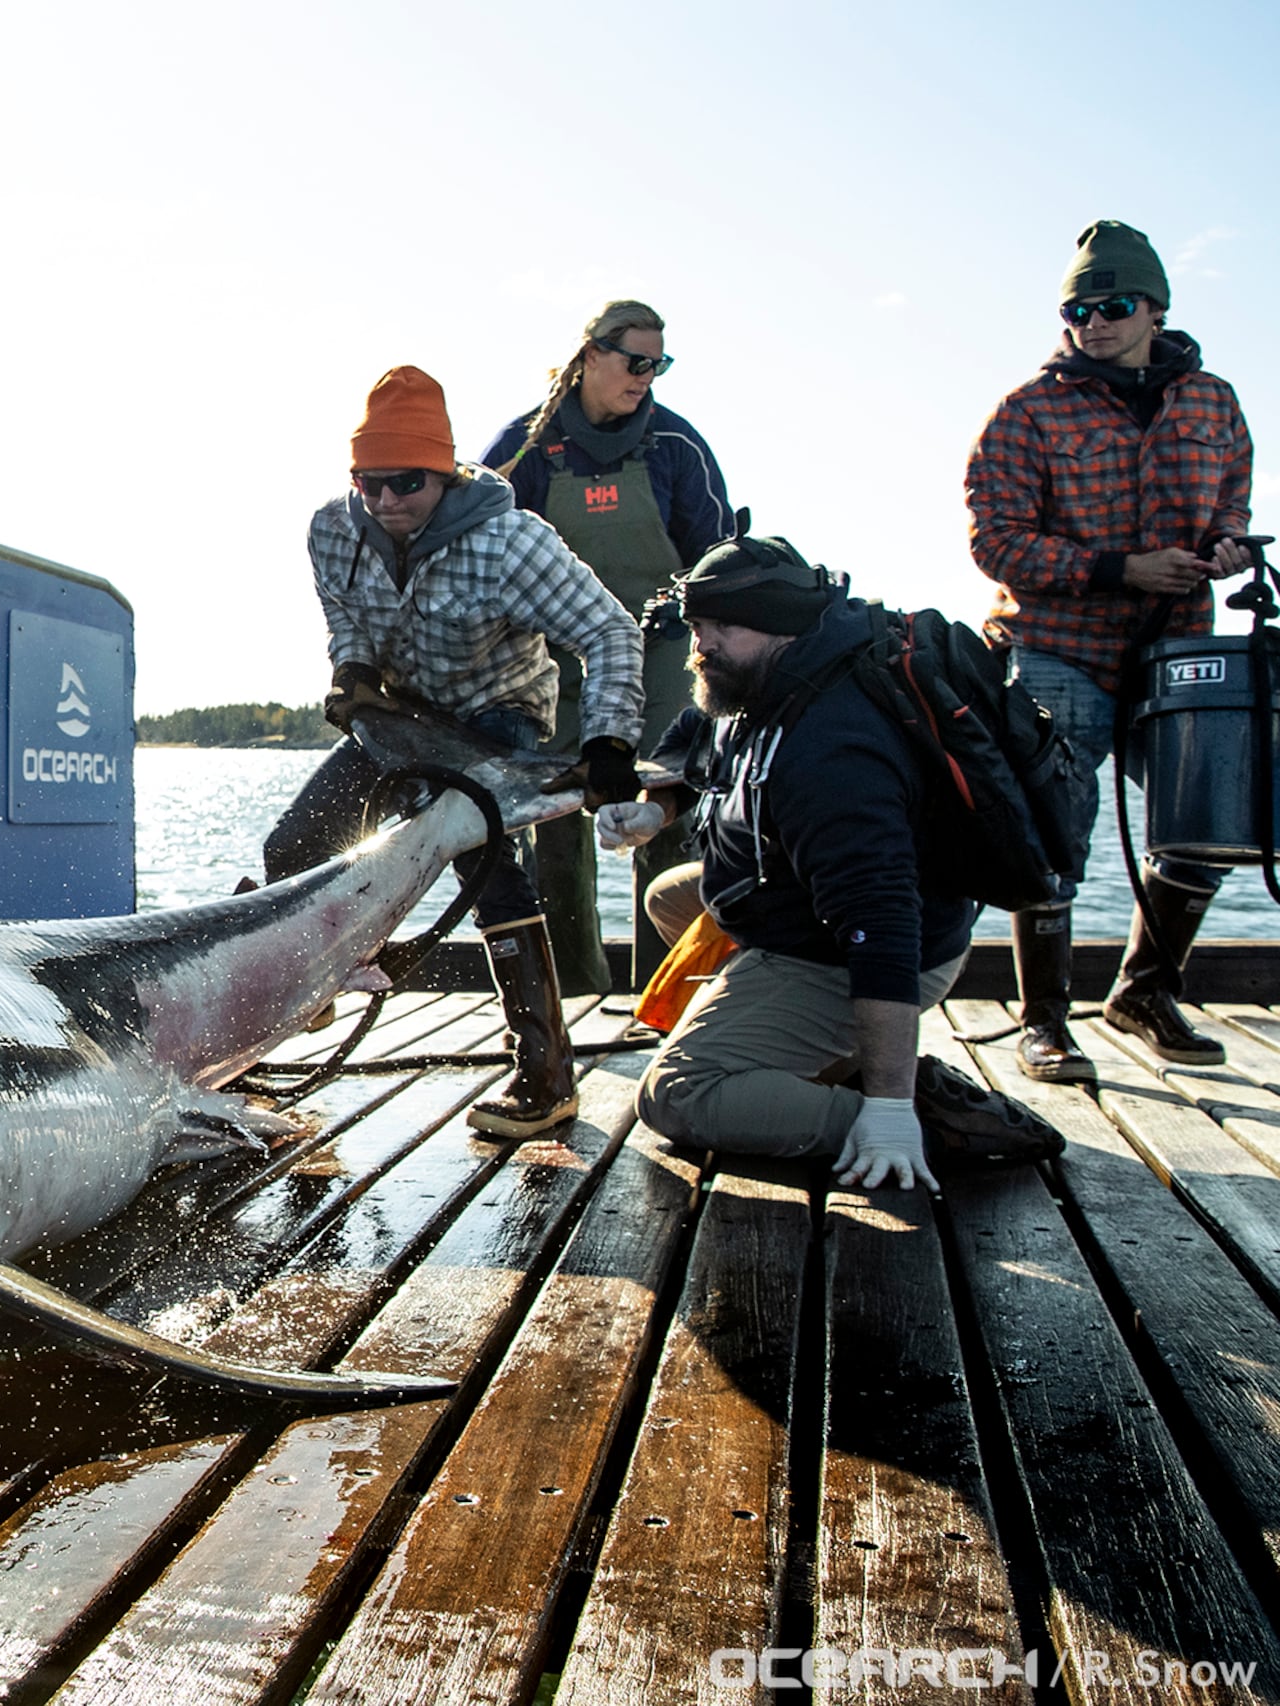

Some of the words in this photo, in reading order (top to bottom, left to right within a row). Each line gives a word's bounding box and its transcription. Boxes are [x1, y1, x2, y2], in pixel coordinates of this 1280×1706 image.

[584, 485, 619, 506] HH
[1169, 661, 1220, 681] YETI
[22, 748, 118, 784] OCEARCH
